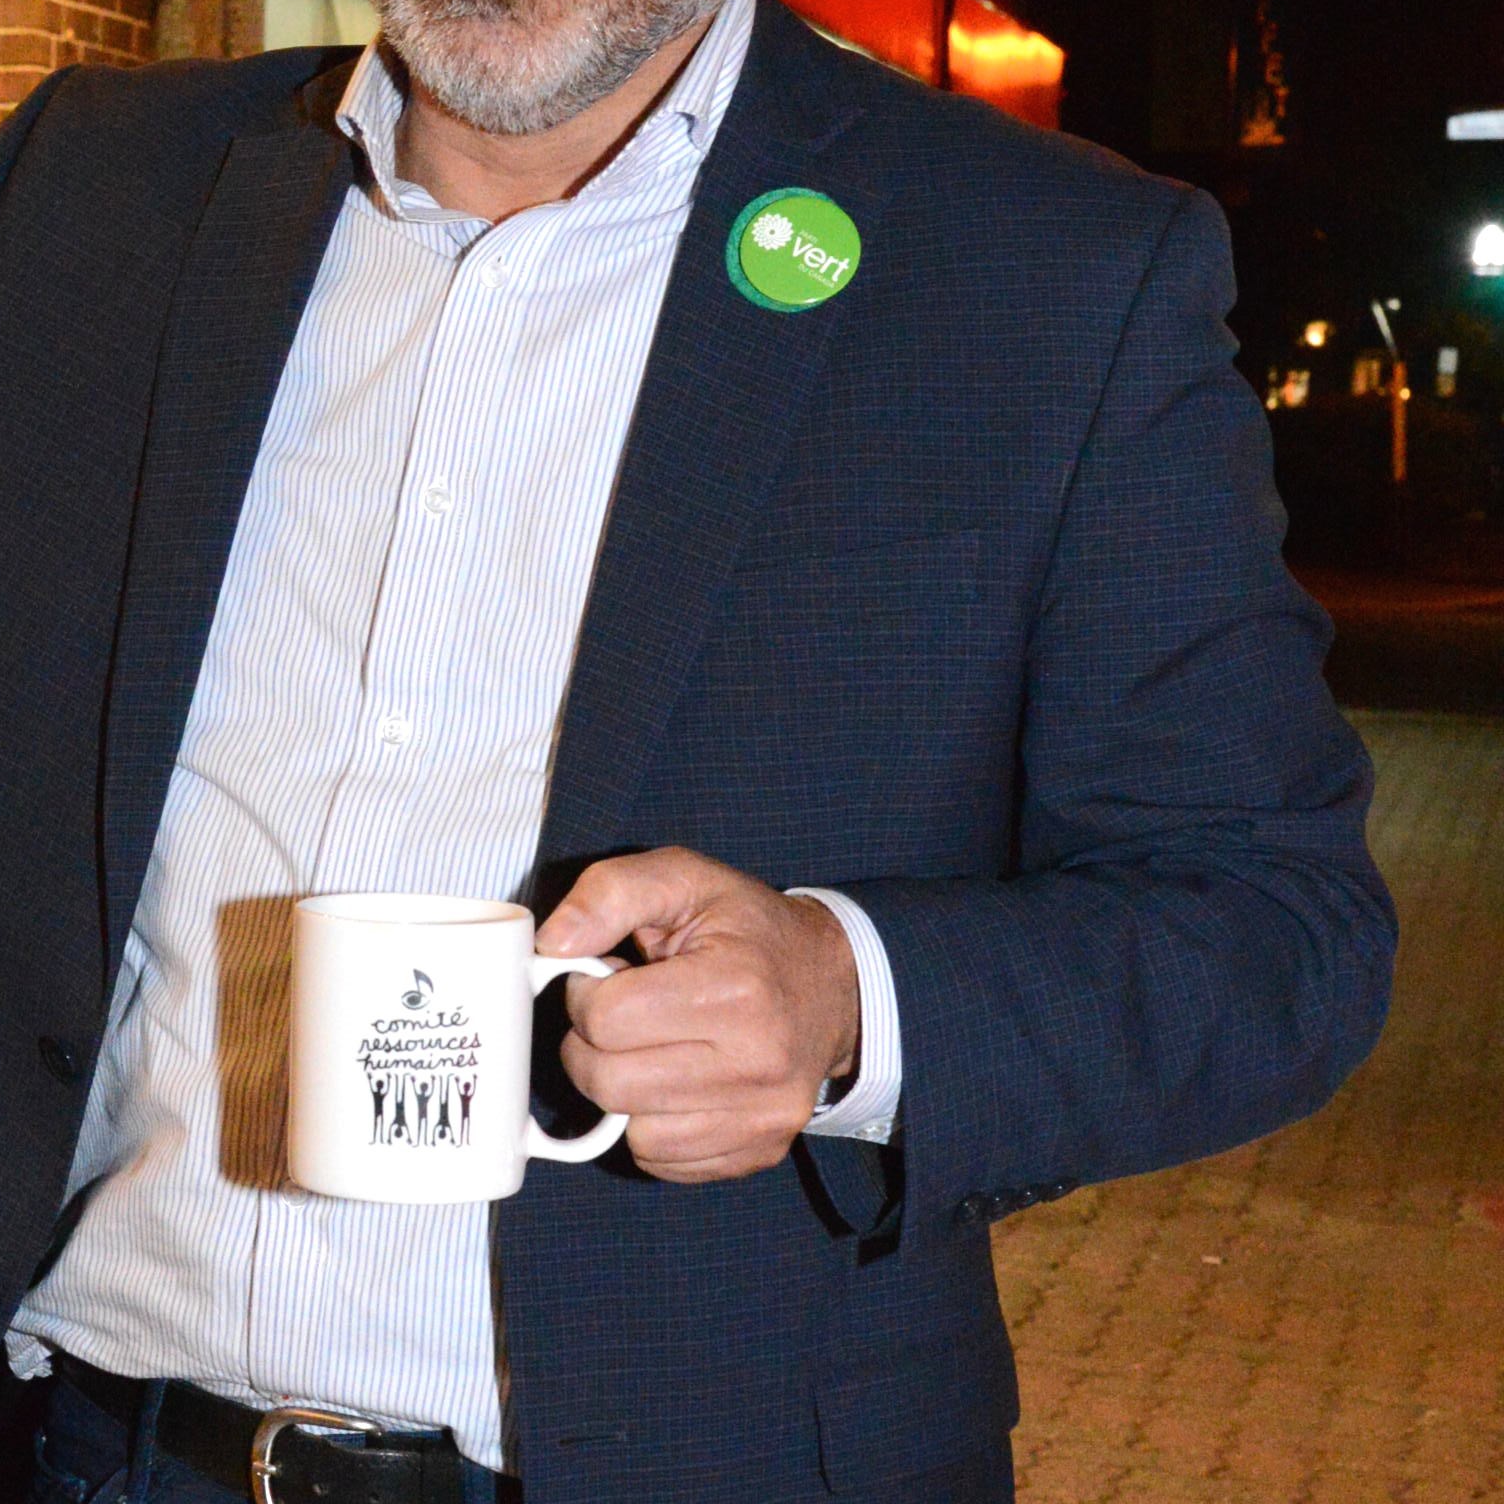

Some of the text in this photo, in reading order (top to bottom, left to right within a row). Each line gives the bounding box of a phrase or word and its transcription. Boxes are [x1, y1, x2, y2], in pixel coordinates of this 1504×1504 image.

[792, 236, 850, 282] vert
[371, 1006, 470, 1033] comité
[358, 1033, 482, 1054] ressources
[356, 1052, 479, 1071] humaines
